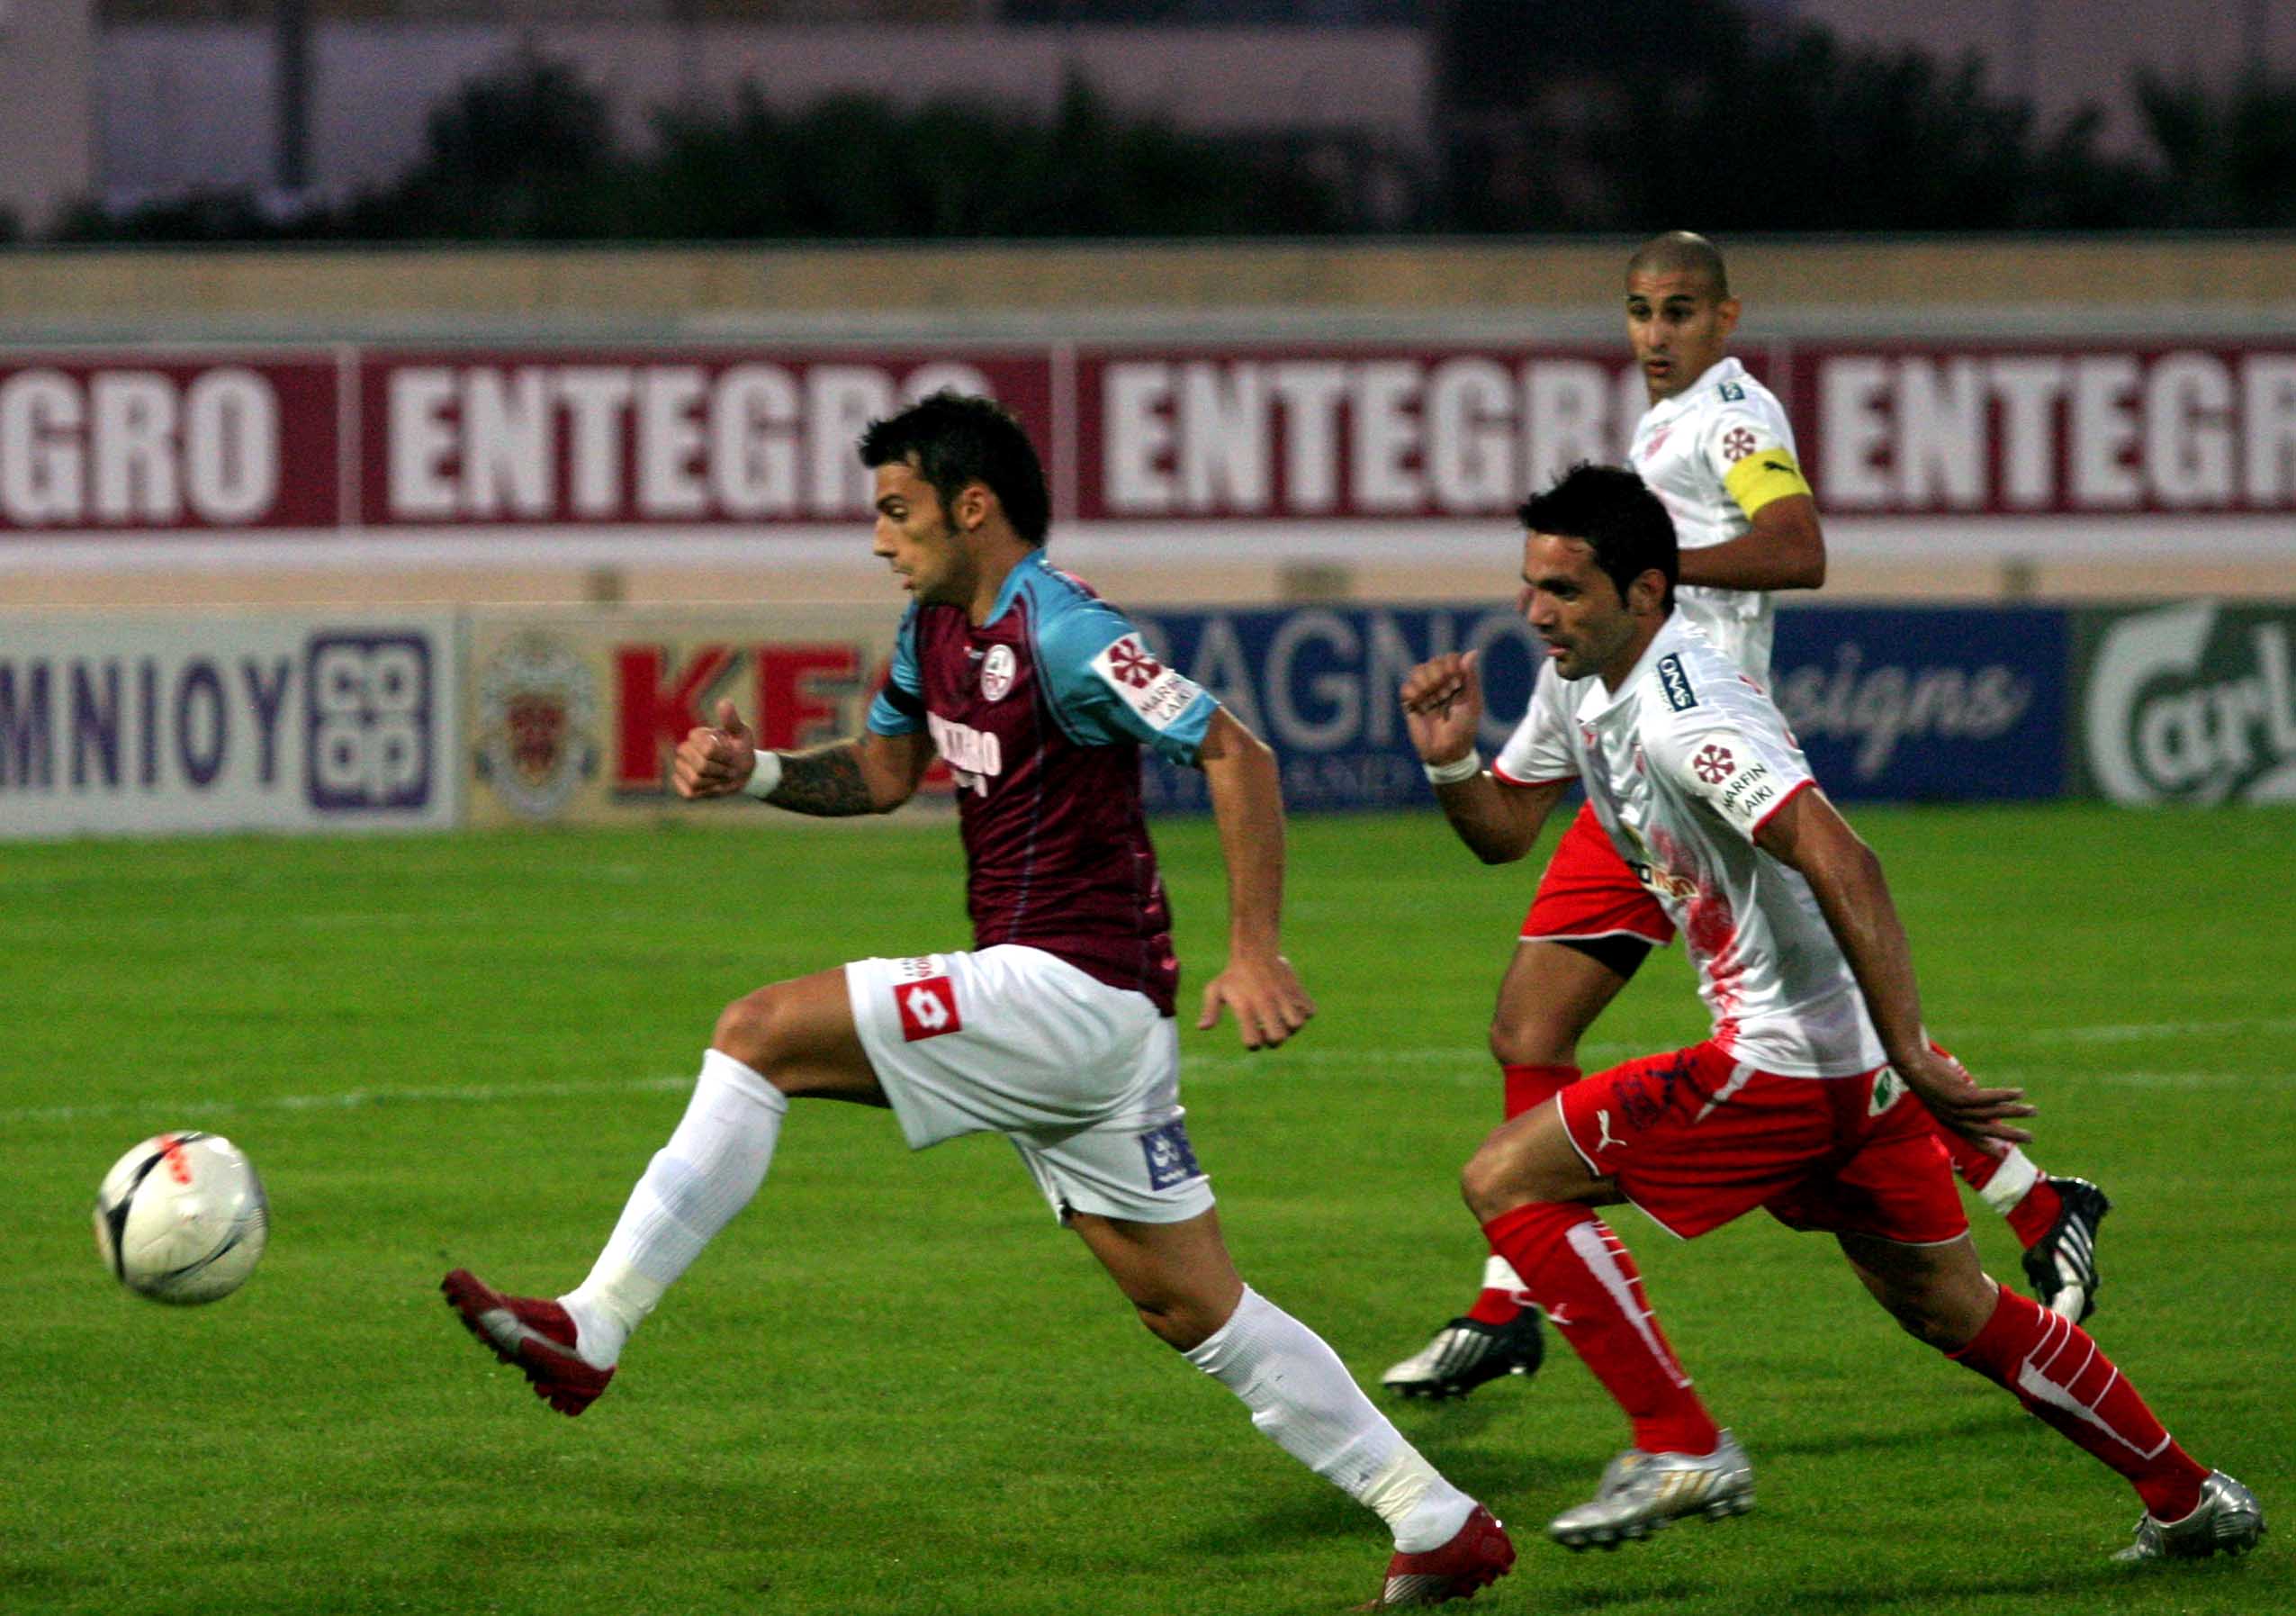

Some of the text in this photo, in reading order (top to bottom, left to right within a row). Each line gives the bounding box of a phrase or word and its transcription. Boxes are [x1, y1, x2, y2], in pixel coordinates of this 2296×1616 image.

[0, 367, 281, 524] GRO
[387, 362, 990, 524] ENTEGR
[1104, 360, 1649, 519] ENTEGR
